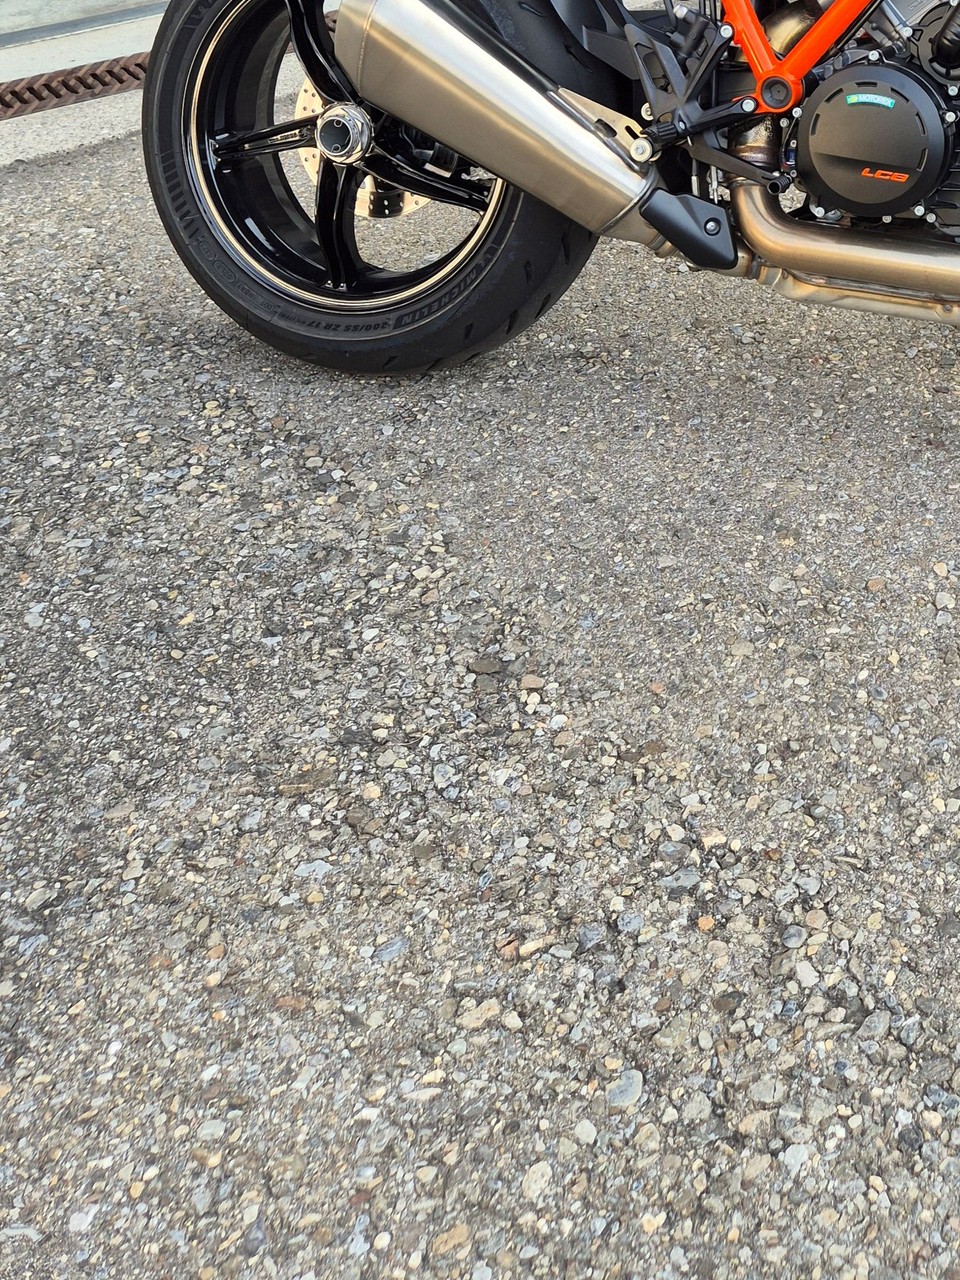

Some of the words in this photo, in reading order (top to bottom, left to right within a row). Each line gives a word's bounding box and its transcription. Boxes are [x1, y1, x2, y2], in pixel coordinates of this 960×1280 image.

[861, 167, 910, 183] LC8
[402, 268, 477, 326] MICHELIN
[307, 320, 323, 330] 17
[324, 321, 341, 331] ZR
[343, 320, 388, 332] 200/55
